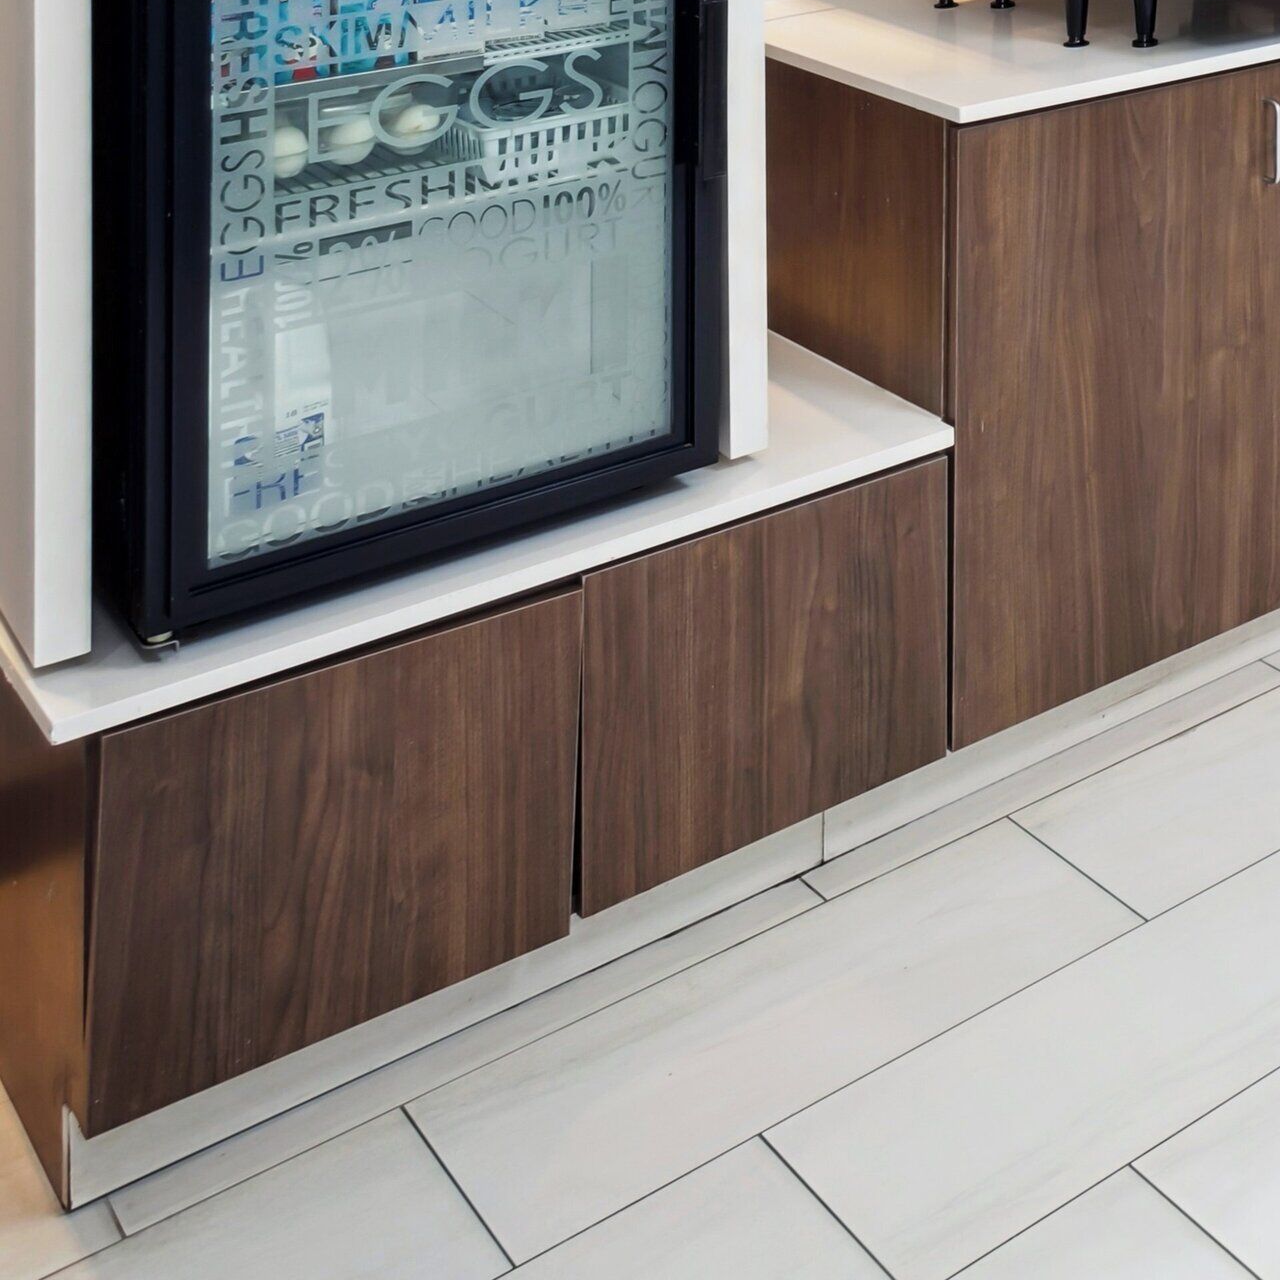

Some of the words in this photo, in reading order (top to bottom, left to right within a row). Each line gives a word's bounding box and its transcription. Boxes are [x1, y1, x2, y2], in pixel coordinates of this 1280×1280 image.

[308, 48, 603, 165] EGGS
[220, 149, 266, 283] EGGS
[274, 170, 456, 236] FRESH
[419, 198, 536, 248] GOOD
[543, 179, 627, 228] 100%
